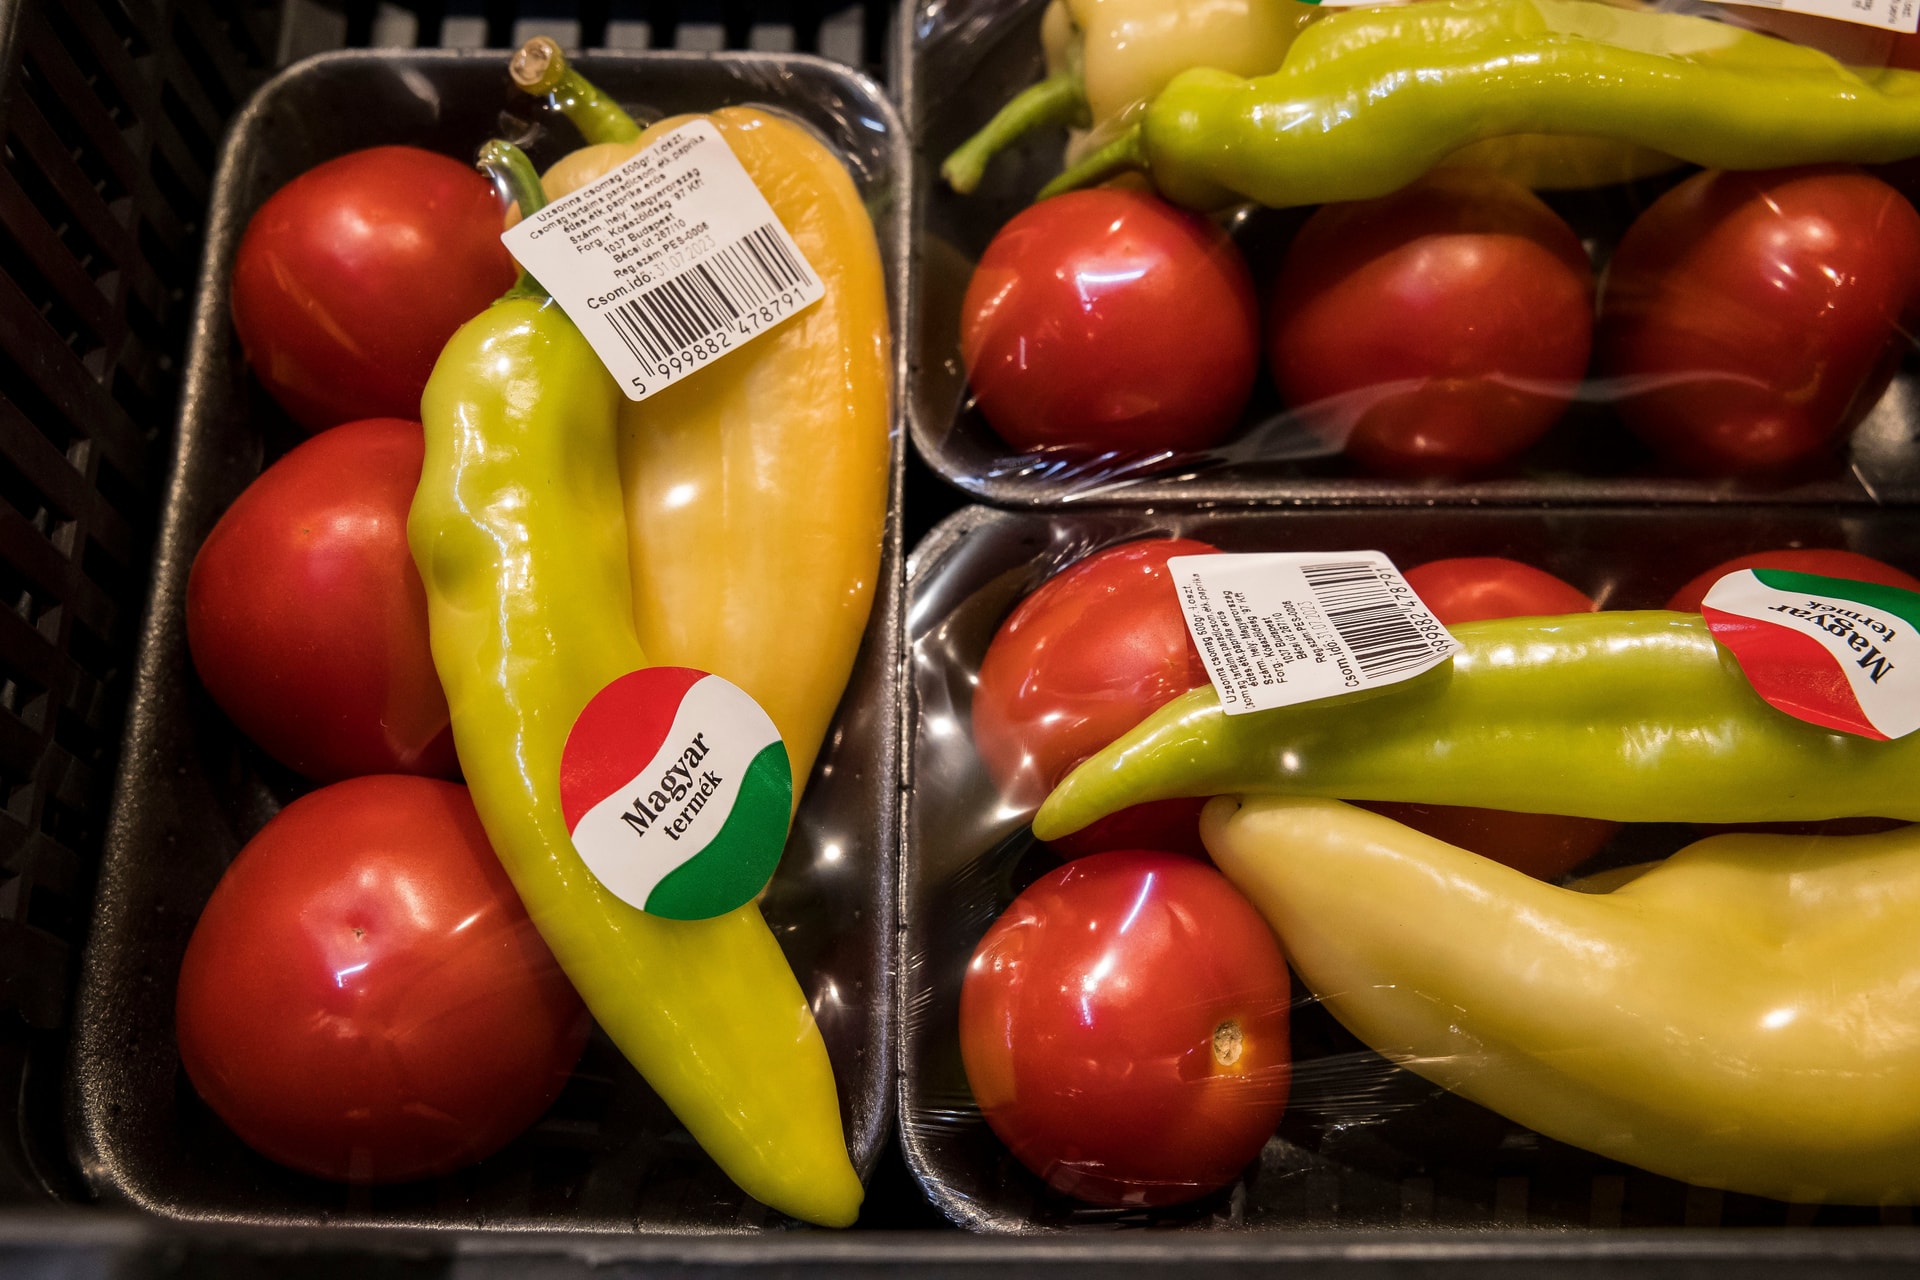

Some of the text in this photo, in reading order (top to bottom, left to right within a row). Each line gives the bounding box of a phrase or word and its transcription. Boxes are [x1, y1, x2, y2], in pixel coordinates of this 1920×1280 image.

[536, 195, 582, 222] Uzsonna
[583, 174, 623, 198] csomag
[606, 208, 632, 226] hely:
[630, 167, 701, 212] Magyarország
[529, 214, 568, 240] Csomag
[604, 212, 676, 255] 1037 Budapest
[613, 244, 642, 264] Bécsi
[642, 237, 654, 249] út
[587, 235, 717, 310] Csom.idő: 31.07.2023
[632, 288, 806, 395] 5 999882 478791
[1223, 590, 1252, 640] Magyarország
[1375, 567, 1456, 652] 999882 478791
[1805, 600, 1896, 643] termék
[1202, 636, 1221, 666] csomag
[1246, 640, 1261, 657] hely:
[1262, 616, 1295, 664] 1037 Budapest
[1285, 633, 1297, 642] út
[1288, 642, 1308, 660] Bécsi
[1297, 600, 1360, 687] Csom.idő: 31.07.2023
[1768, 604, 1895, 685] Magyar
[1216, 666, 1237, 704] Uzsonna
[620, 732, 710, 838] Magyar
[663, 770, 723, 841] termék
